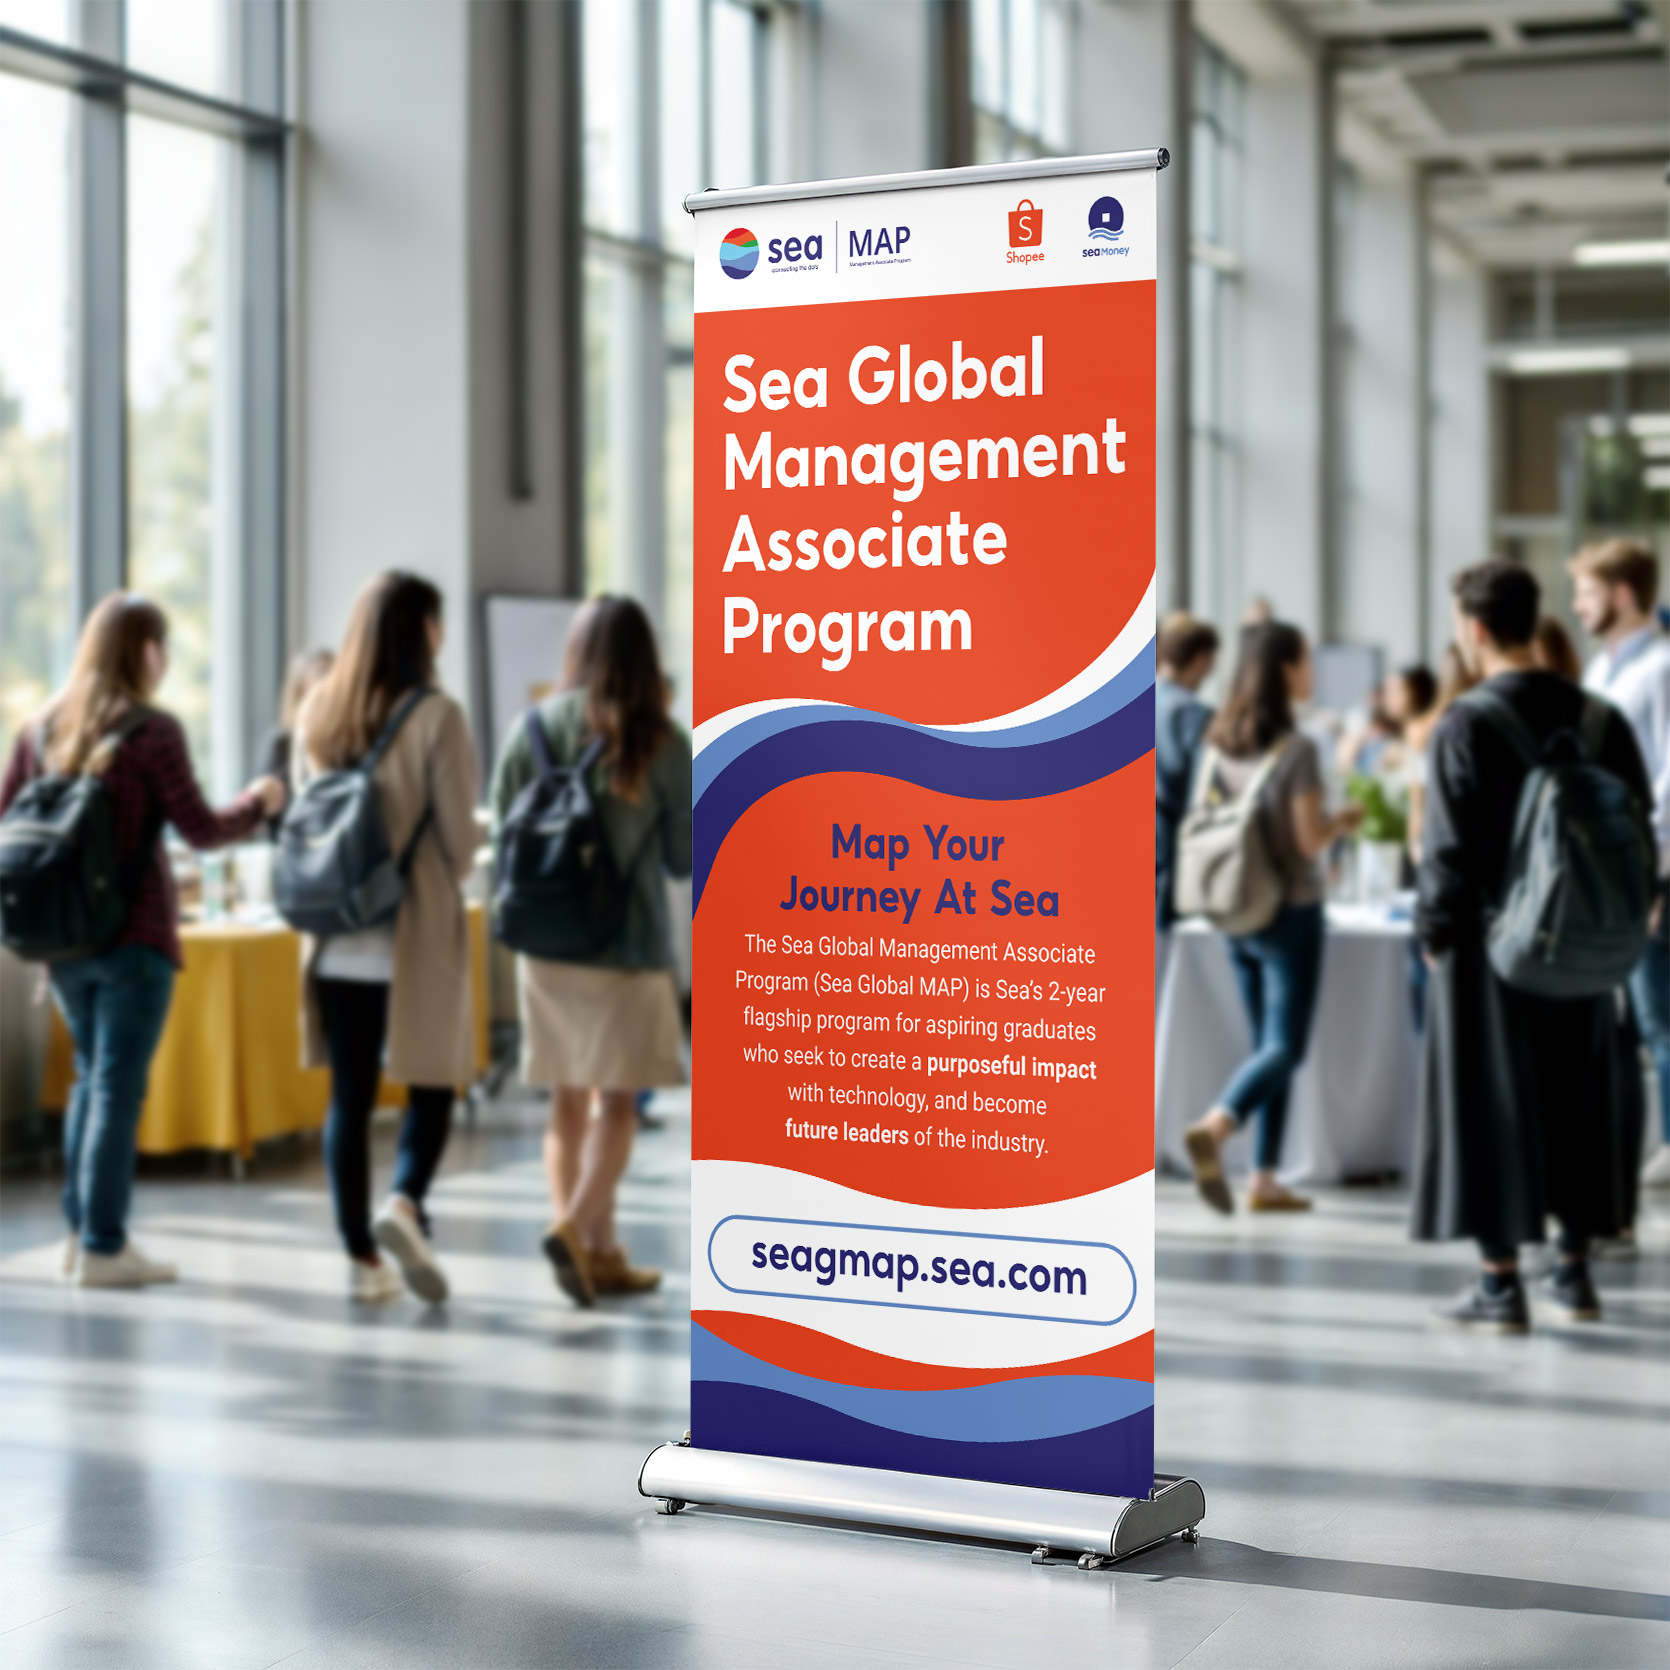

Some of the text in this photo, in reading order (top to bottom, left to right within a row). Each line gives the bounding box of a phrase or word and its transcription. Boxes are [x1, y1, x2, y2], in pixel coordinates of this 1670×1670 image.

[768, 235, 822, 263] sea
[849, 226, 911, 257] MAP
[1006, 251, 1045, 265] Shopee
[724, 336, 1043, 413] Sea Global
[726, 418, 1125, 503] Management
[723, 510, 1007, 572] Associate
[724, 597, 971, 671] Program
[833, 824, 1004, 871] Map Your
[780, 875, 1058, 924] Journey At Sea
[745, 934, 1095, 964] The Sea Global Management Associate
[736, 970, 807, 994] Program
[815, 972, 851, 996] (Sea
[858, 975, 913, 996] Global
[920, 977, 968, 1002] MAP)
[976, 979, 990, 999] is
[1049, 981, 1105, 1006] 2-year
[744, 1006, 1096, 1042] flagship program for aspiring graduates
[744, 1043, 1096, 1083] who seek to create a purposeful impact
[788, 1083, 1046, 1115] with technology, and become
[786, 1118, 1048, 1158] future leaders of the industry.
[752, 1241, 1087, 1296] seagmap.sea.com
